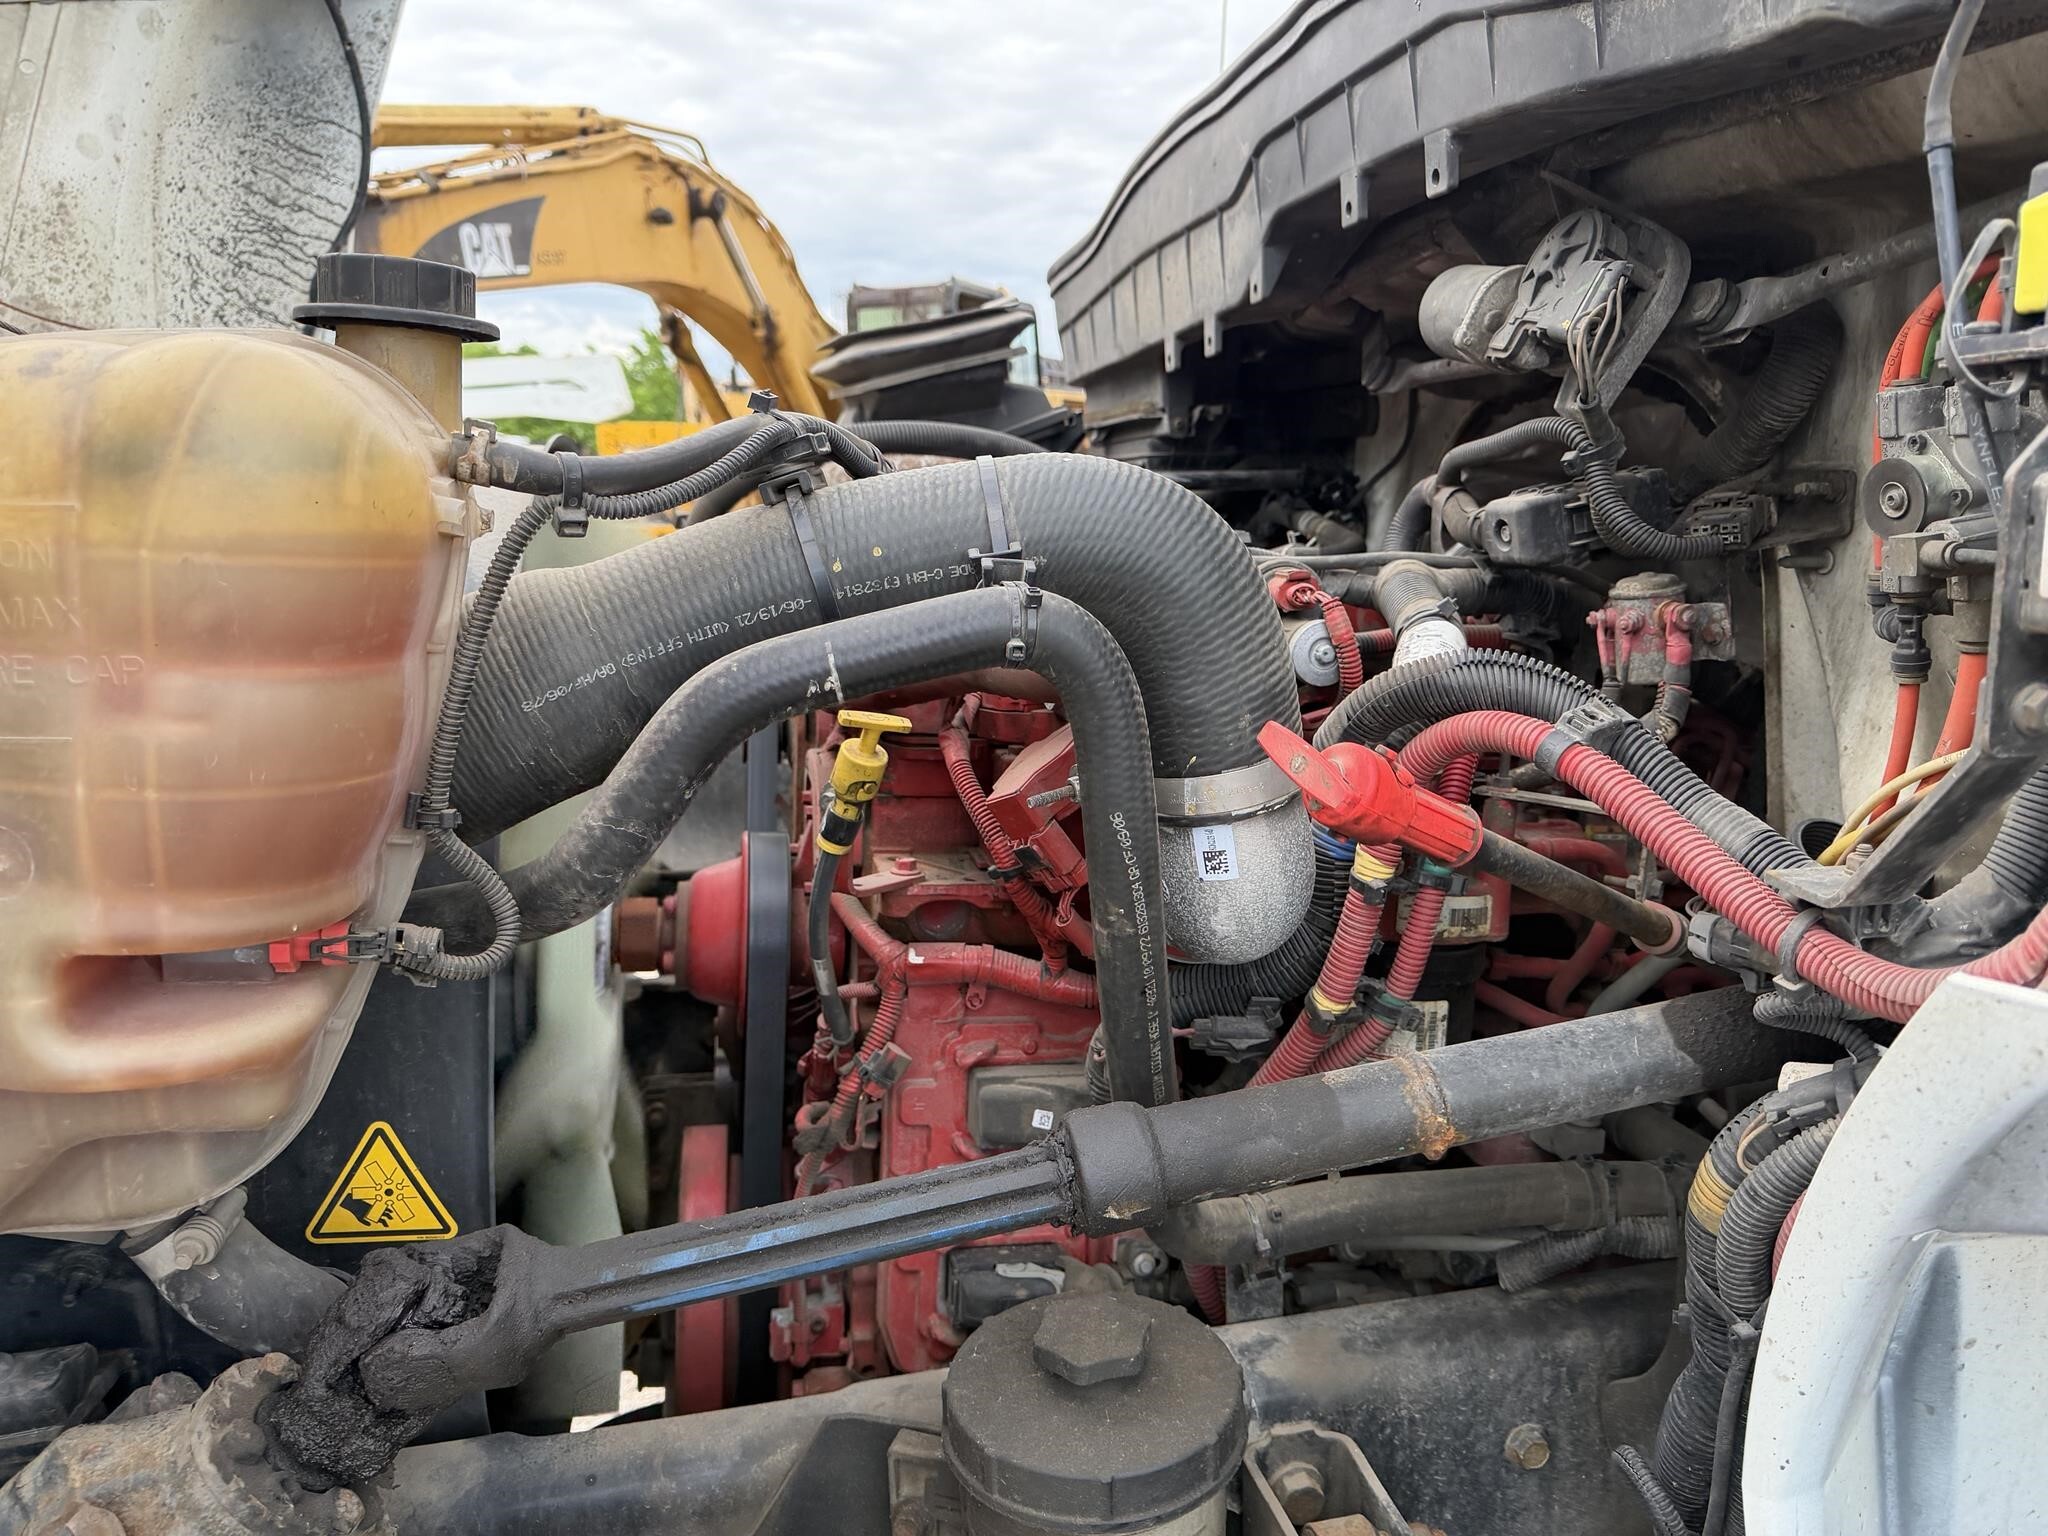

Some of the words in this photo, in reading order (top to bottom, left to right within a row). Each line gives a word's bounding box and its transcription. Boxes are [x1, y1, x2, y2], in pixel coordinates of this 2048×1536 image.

[459, 222, 518, 278] CAT
[1970, 412, 2003, 507] SYNFLE
[66, 655, 145, 685] CAP
